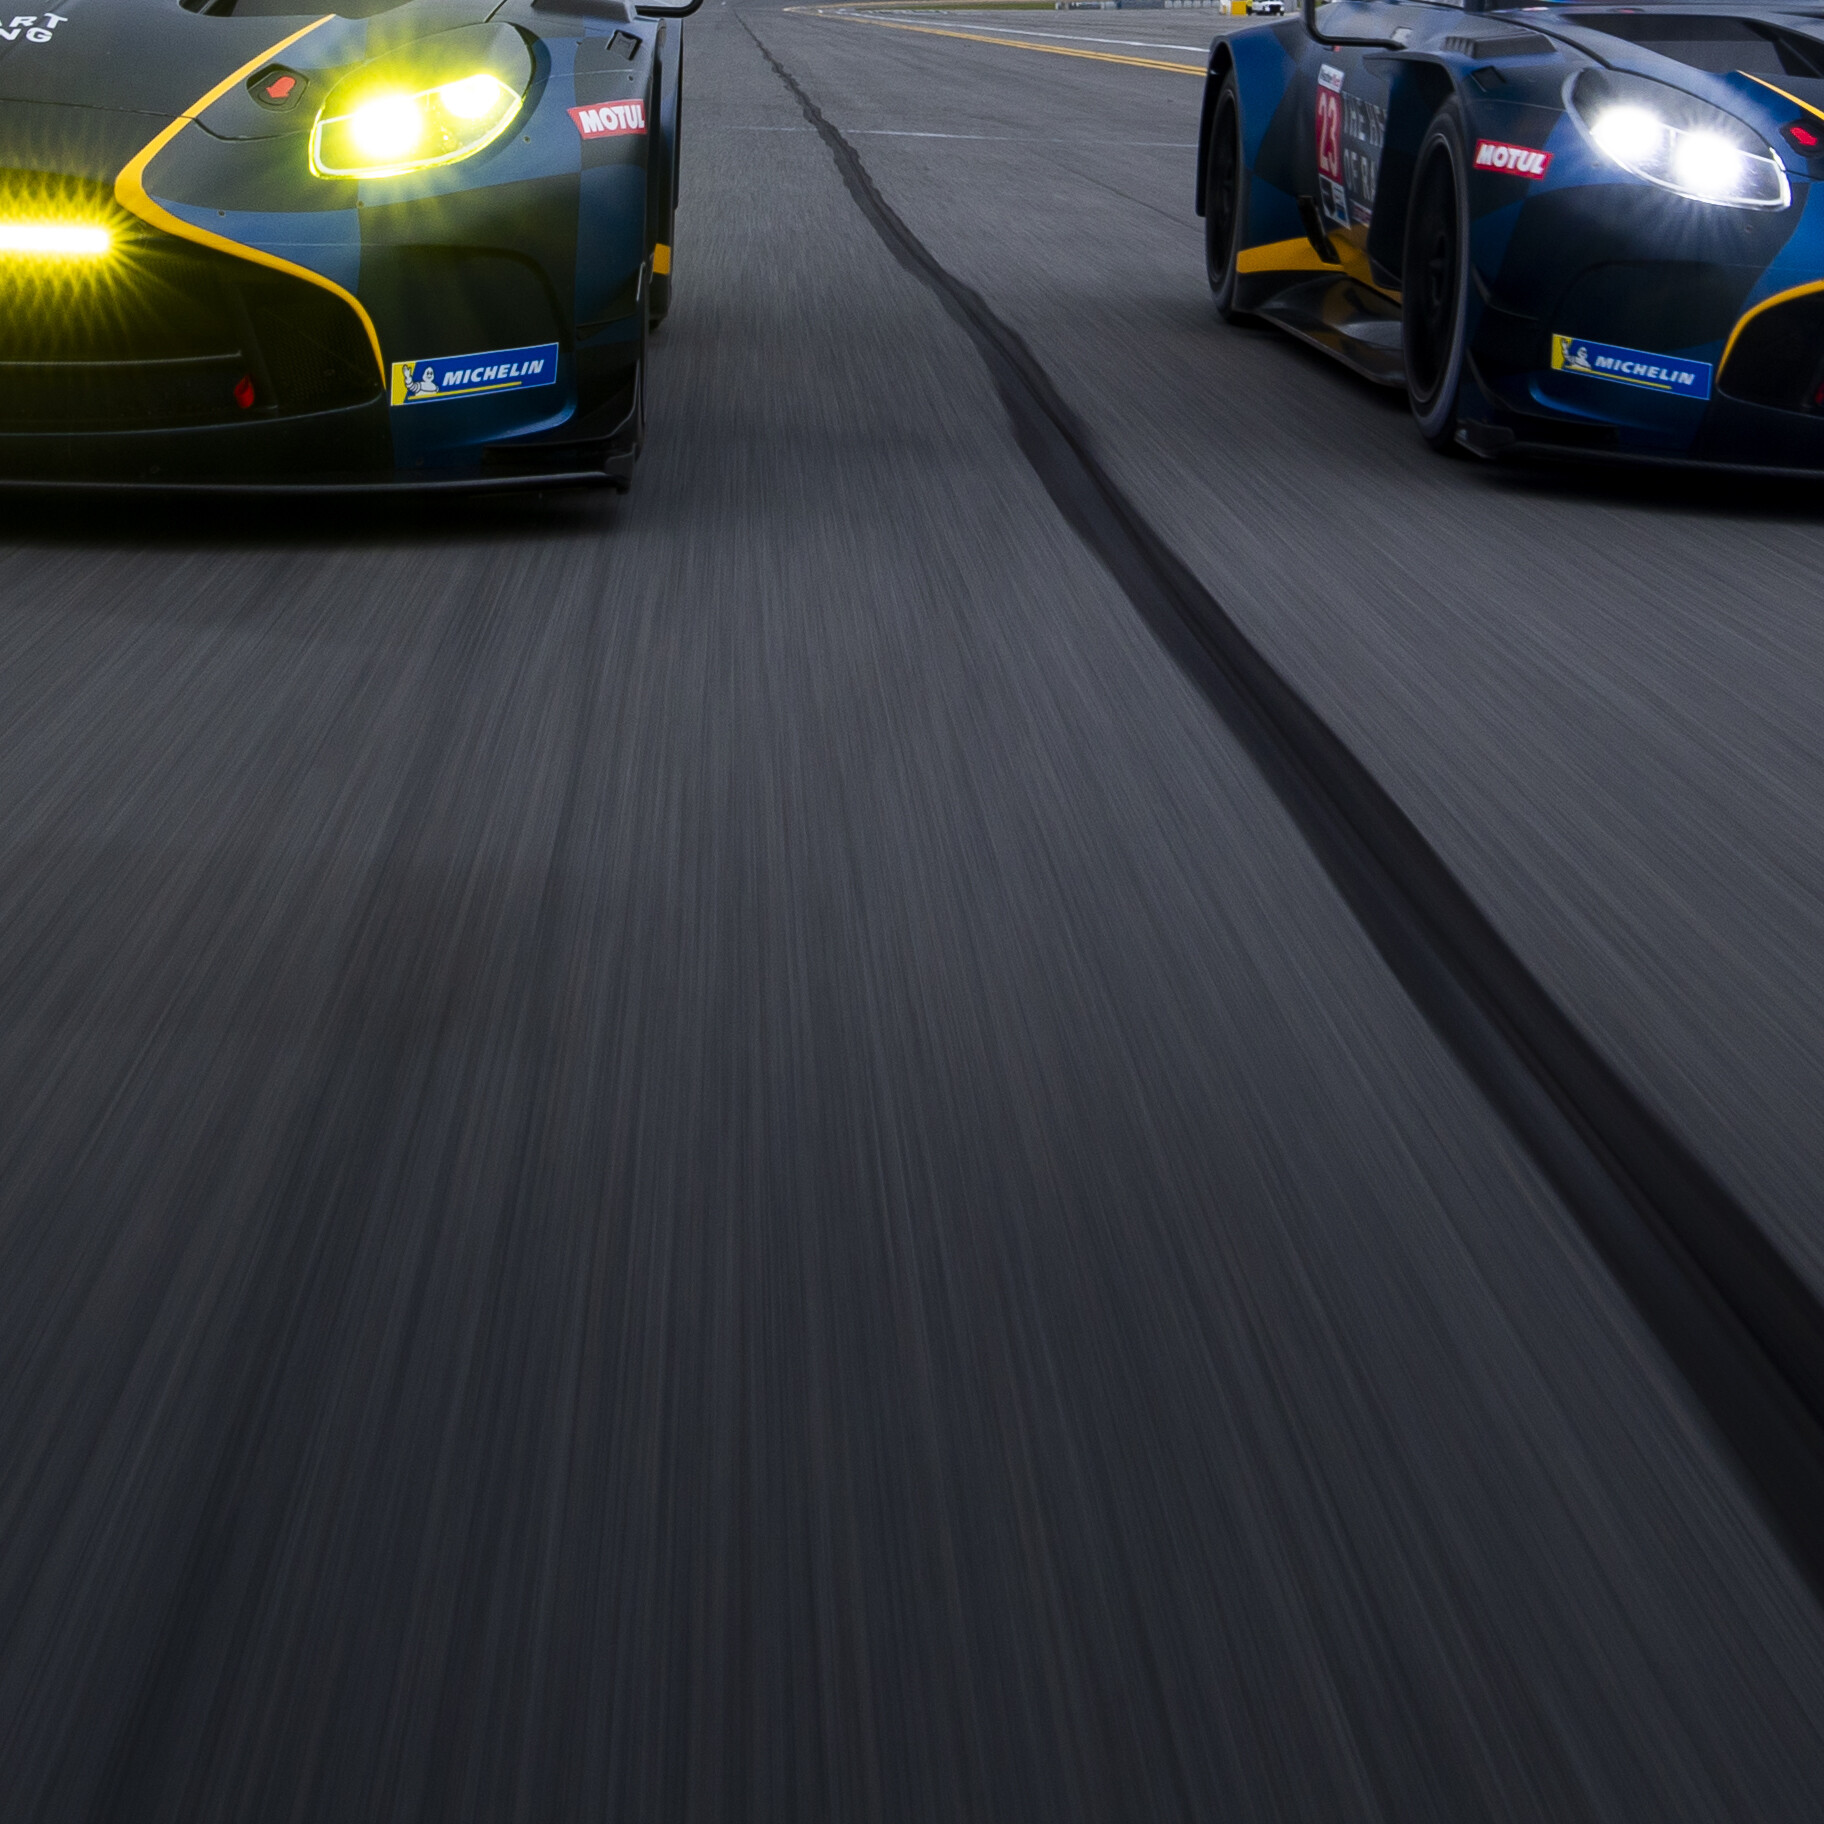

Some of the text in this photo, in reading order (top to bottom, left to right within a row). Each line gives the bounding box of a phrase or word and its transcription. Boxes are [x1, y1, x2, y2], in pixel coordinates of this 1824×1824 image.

[579, 104, 645, 133] MOTUL
[1318, 90, 1339, 178] 23
[1476, 143, 1546, 175] MOTUL
[442, 359, 545, 386] MICHELIN
[1595, 355, 1696, 385] MICHELIN
